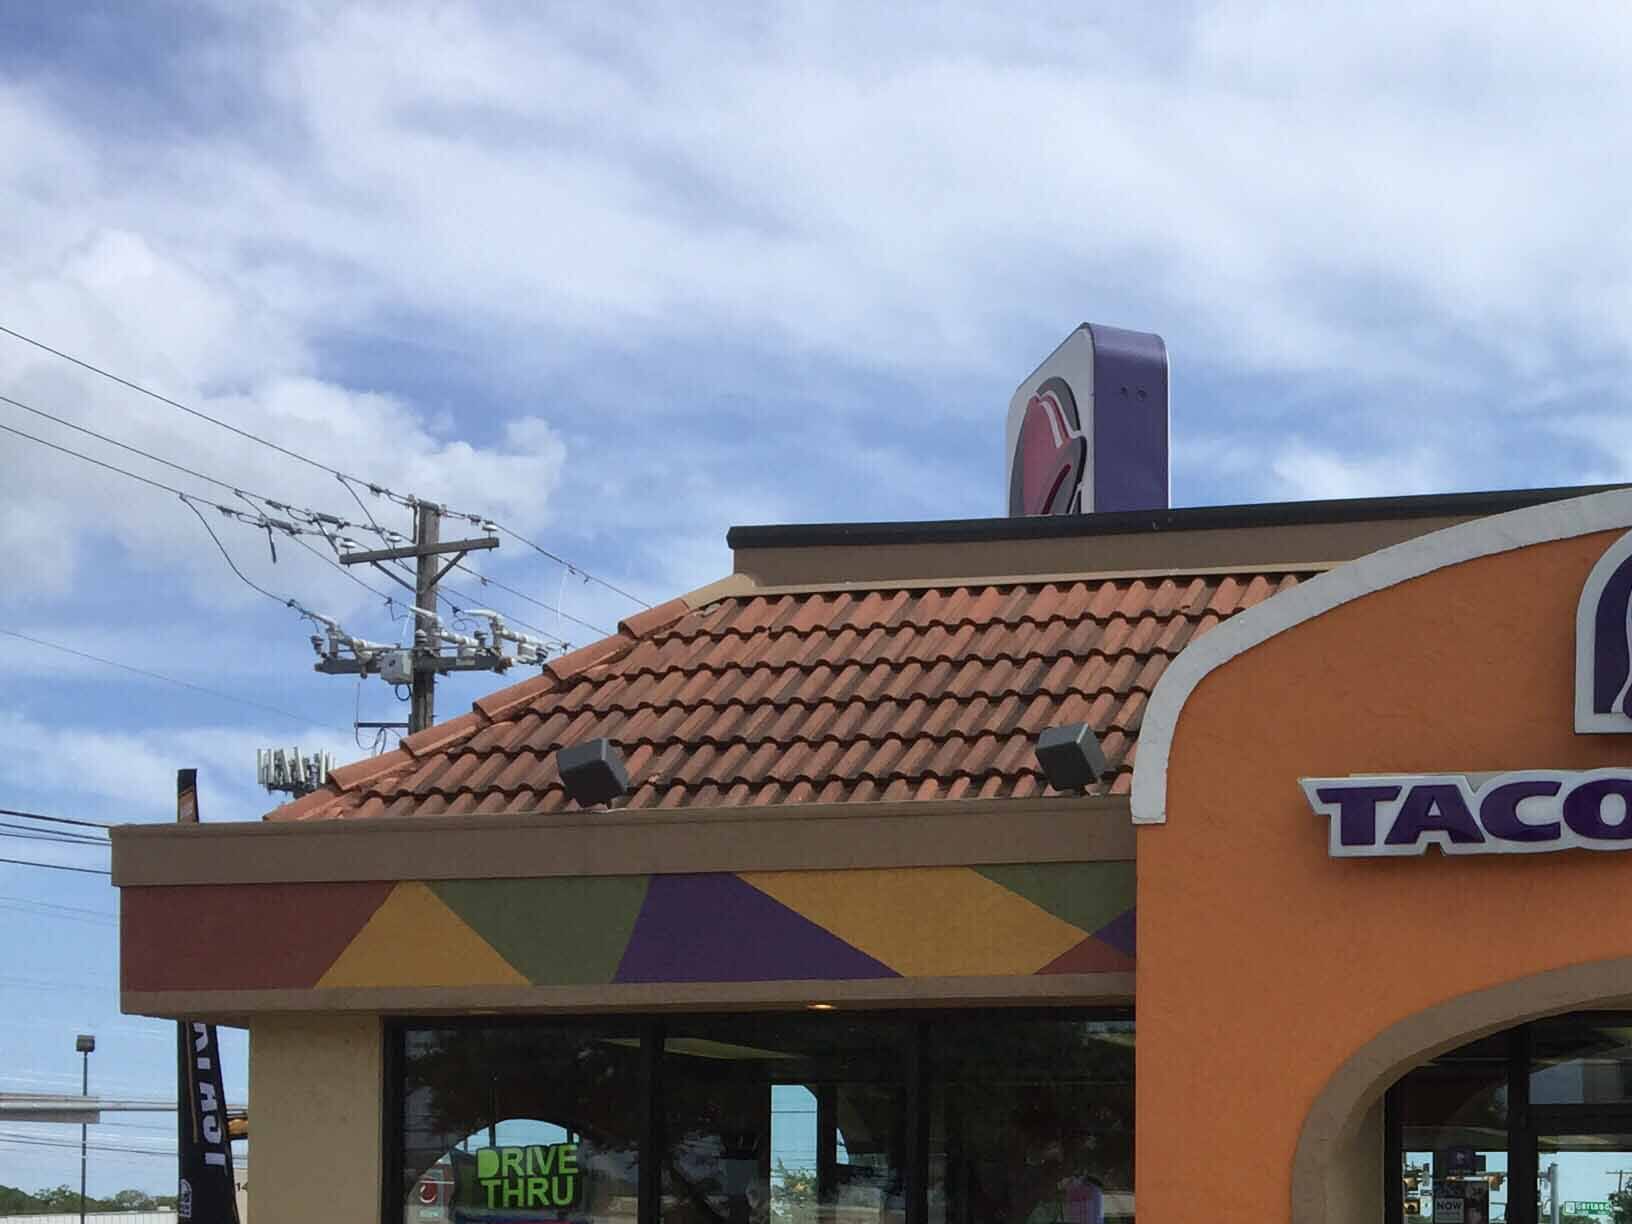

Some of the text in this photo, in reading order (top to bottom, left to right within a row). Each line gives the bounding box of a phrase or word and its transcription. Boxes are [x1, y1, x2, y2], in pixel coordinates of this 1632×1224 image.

[476, 1144, 579, 1179] DRIVE
[481, 1176, 574, 1209] THRU
[1437, 1201, 1462, 1211] NOW
